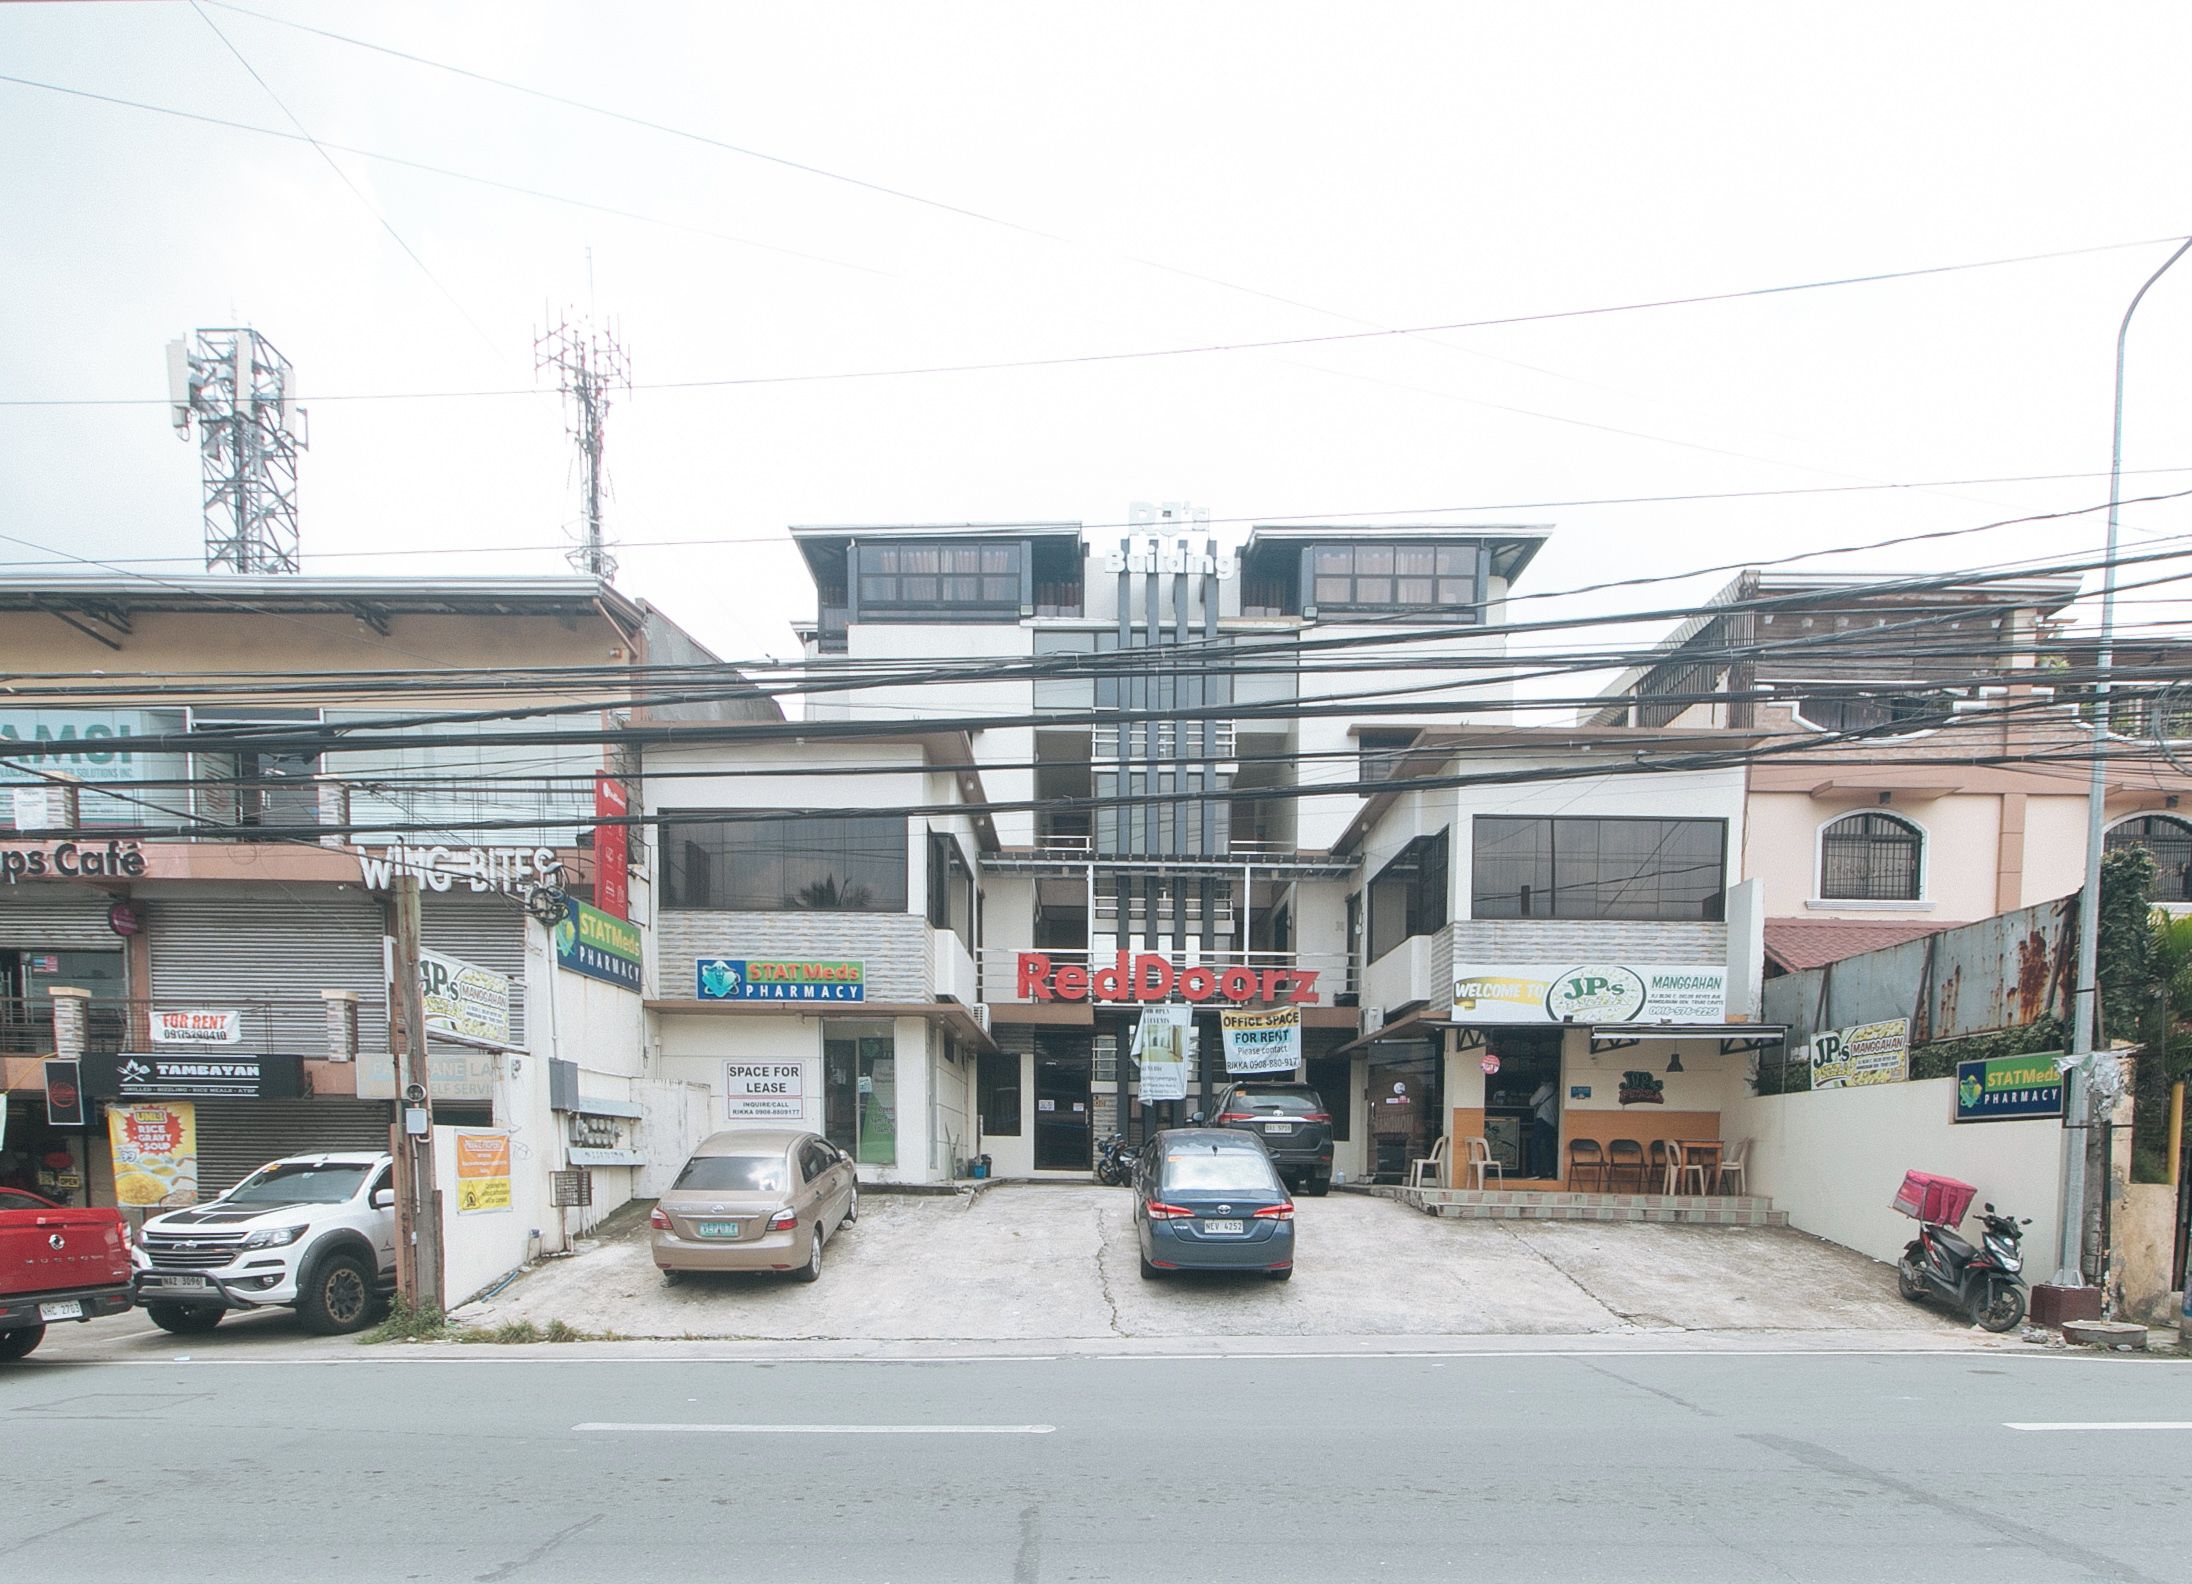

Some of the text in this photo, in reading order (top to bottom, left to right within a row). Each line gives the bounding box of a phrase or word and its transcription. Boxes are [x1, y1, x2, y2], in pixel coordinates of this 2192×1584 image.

[1104, 549, 1235, 580] Building
[54, 841, 148, 877] Café
[357, 846, 451, 892] WING
[579, 945, 640, 983] PHARMACY
[1016, 948, 1320, 1003] RedDoorz
[1652, 976, 1722, 990] MANGGAHAN
[746, 985, 858, 999] PHARMACY
[1455, 983, 1544, 999] WELCOME TO
[1564, 977, 1625, 1000] JP's
[163, 1014, 228, 1030] FOR RENT
[1223, 1012, 1300, 1028] OFFICE SPACE
[1235, 1030, 1289, 1044] FOR RENT
[1237, 1045, 1288, 1056] Please contact
[1813, 1036, 1850, 1068] JP's
[156, 1065, 260, 1077] TAMBAYAN
[729, 1066, 800, 1078] SPACE FOR
[1227, 1061, 1249, 1070] RIKKA
[746, 1083, 787, 1094] LEASE
[1984, 1089, 2058, 1105] PHARMACY
[137, 1125, 167, 1134] RICE
[137, 1134, 173, 1142] GRAVY
[1205, 1222, 1242, 1231] NEV 4252
